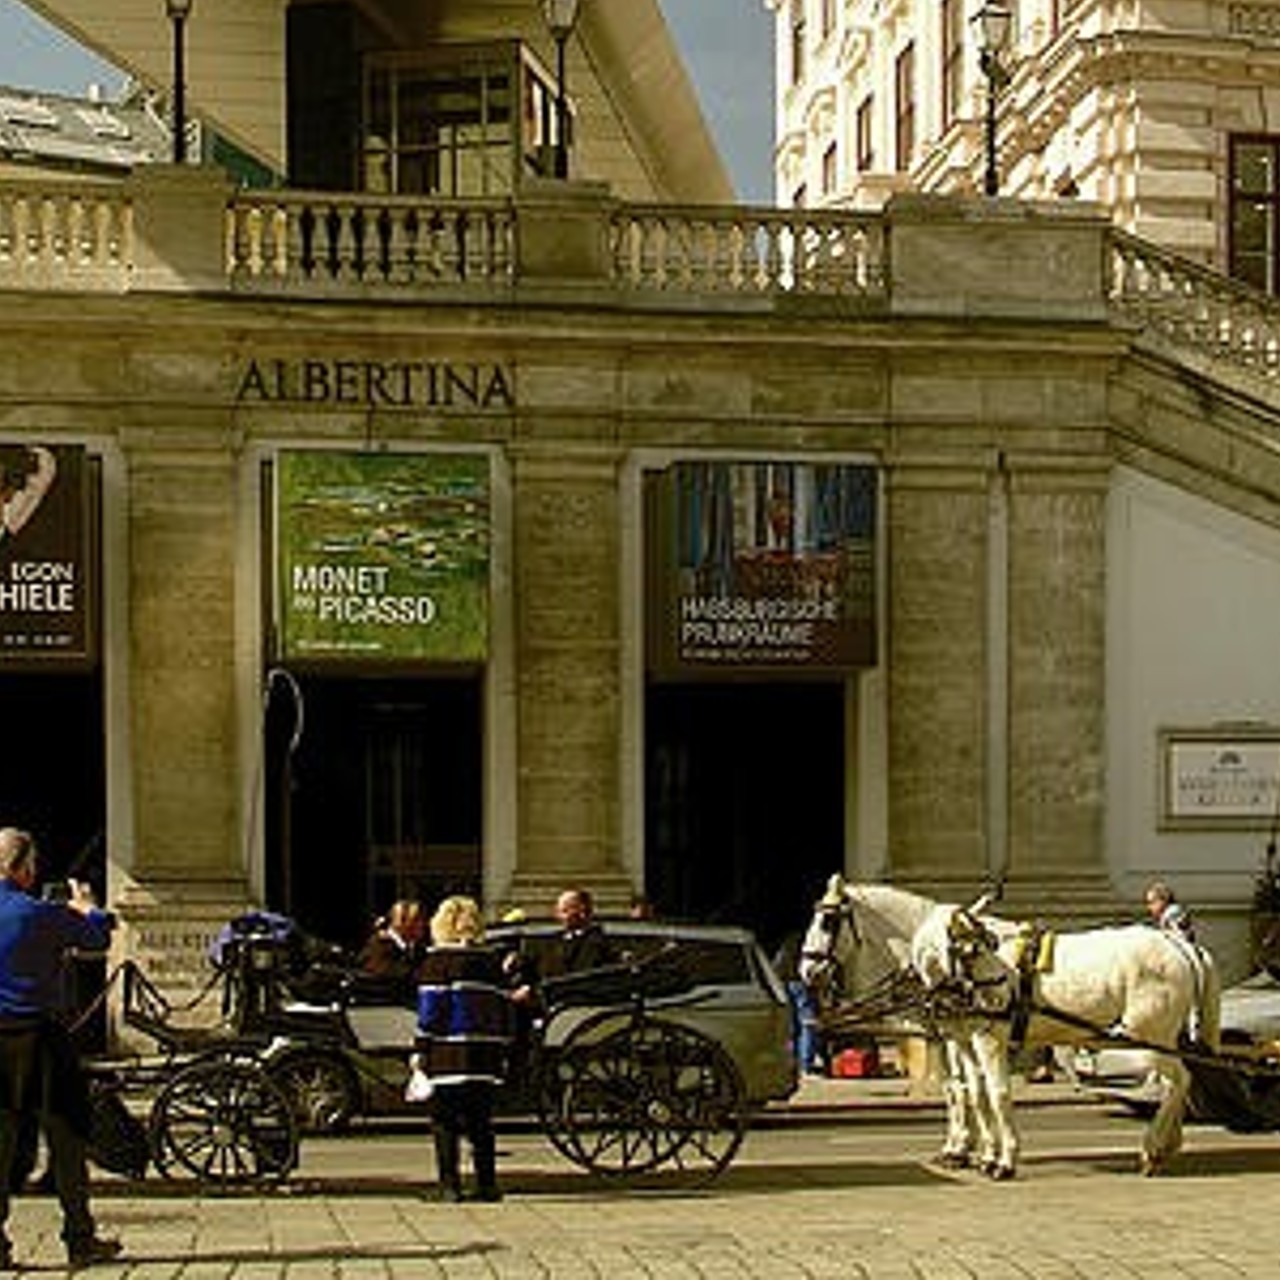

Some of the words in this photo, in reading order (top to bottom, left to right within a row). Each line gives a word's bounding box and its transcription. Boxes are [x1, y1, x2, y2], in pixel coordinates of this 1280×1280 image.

[236, 357, 517, 407] ALBERTINA
[11, 562, 74, 581] EGON
[293, 566, 389, 594] MONET
[320, 596, 436, 624] PICASSO
